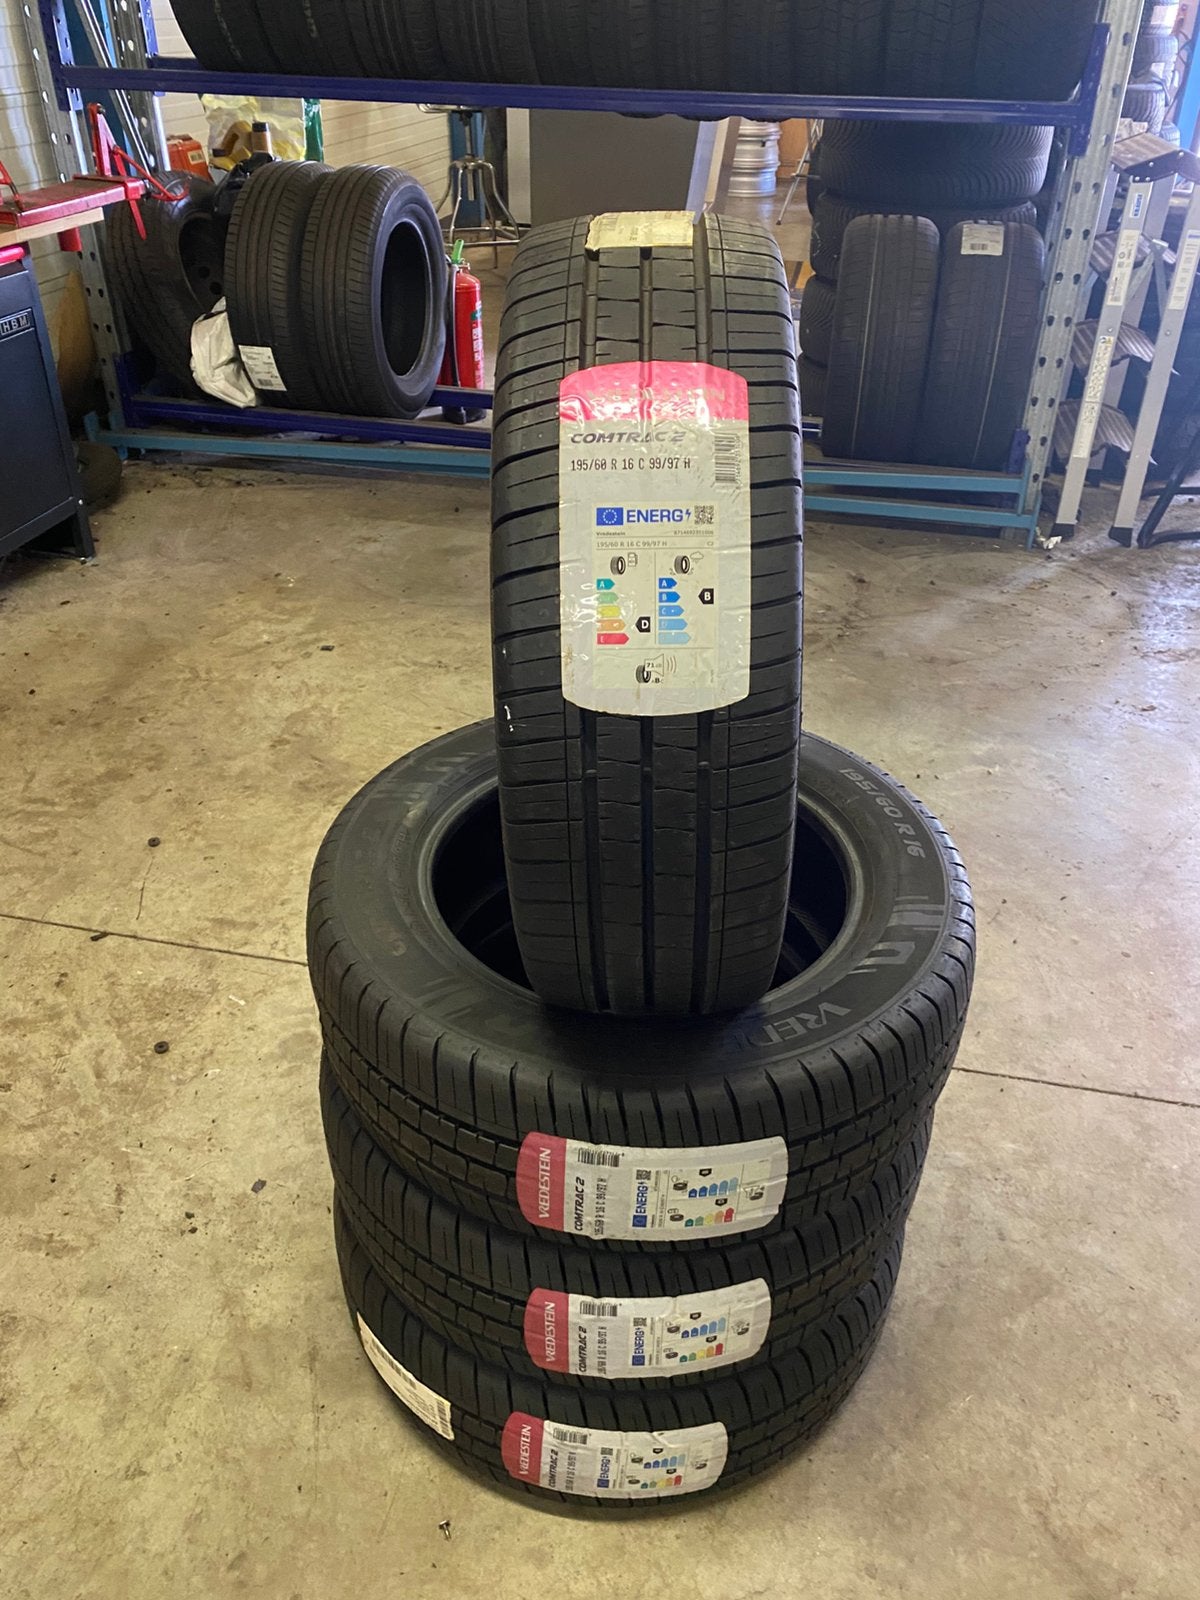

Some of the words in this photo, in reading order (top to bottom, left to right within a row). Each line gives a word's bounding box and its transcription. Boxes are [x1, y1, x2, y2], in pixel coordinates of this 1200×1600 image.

[2, 315, 28, 334] HBM
[571, 432, 668, 444] COMTRAC
[571, 459, 607, 472] 195/60
[611, 459, 618, 470] R
[622, 458, 634, 470] 16
[638, 458, 644, 470] C
[649, 458, 680, 470] 99/97
[684, 458, 690, 470] H
[626, 508, 684, 524] ENERG
[704, 592, 711, 601] B
[641, 620, 650, 629] D
[840, 768, 903, 818] 195/60
[895, 822, 916, 836] R
[904, 839, 926, 859] 16
[538, 1147, 552, 1219] VREDESTEIN
[575, 1176, 585, 1186] 2
[574, 1186, 585, 1232] COMTRAC
[544, 1302, 556, 1362] VREDESTEIN
[578, 1334, 587, 1373] COMTRAC
[519, 1424, 532, 1475] VREDESTEIN
[548, 1456, 558, 1488] COMTRAC
